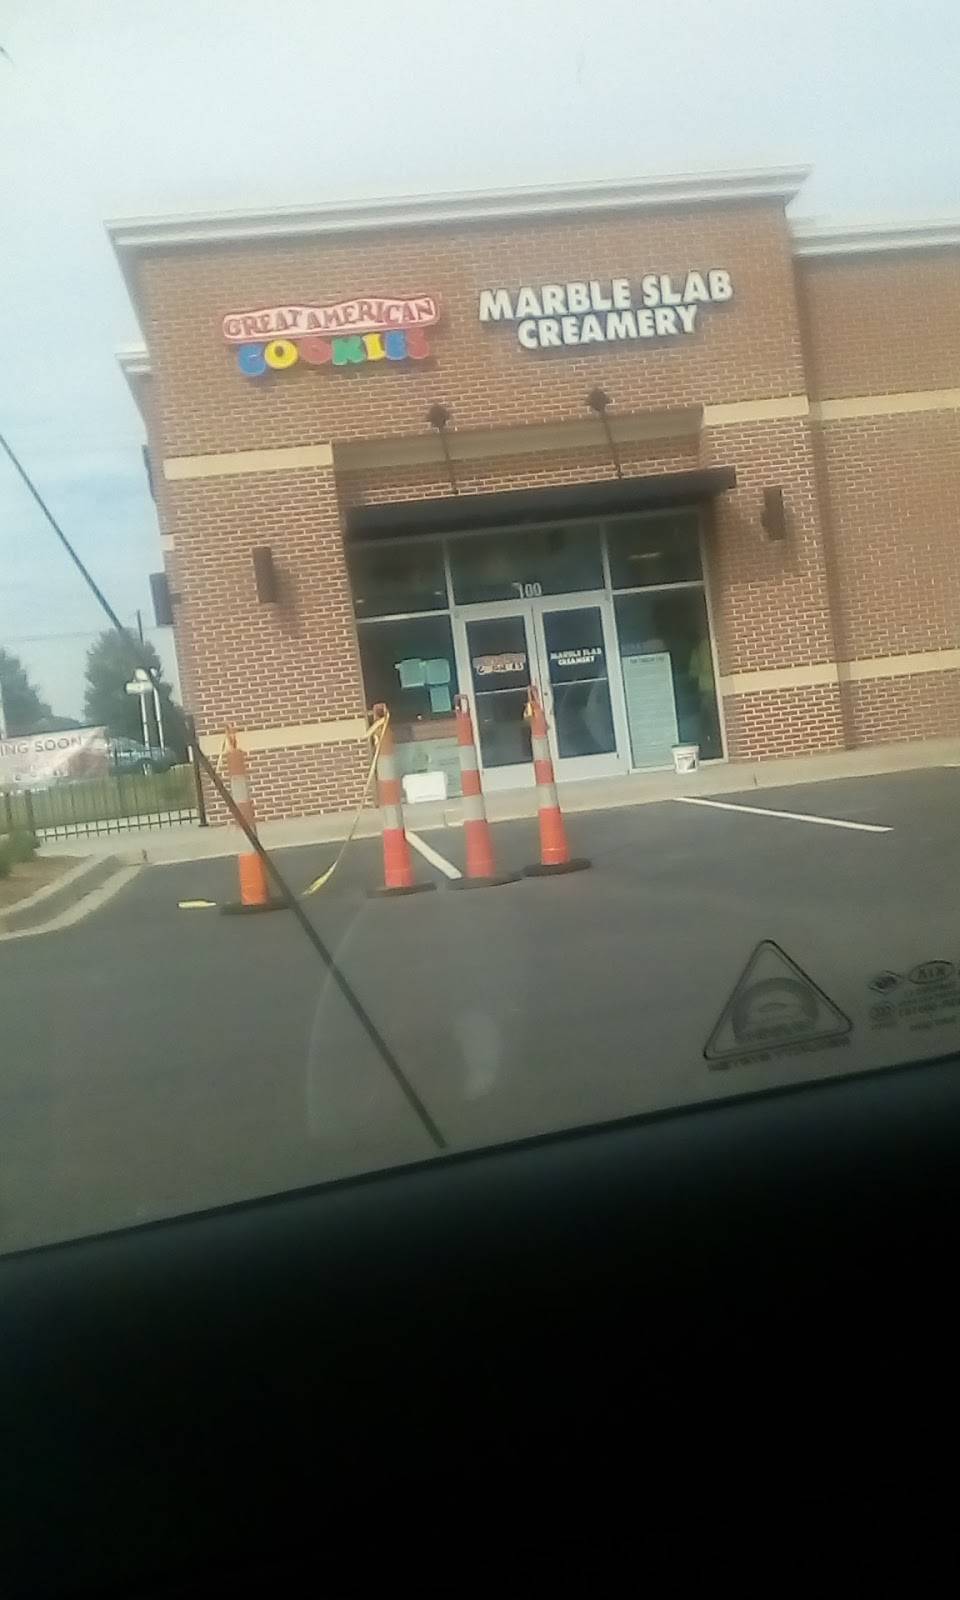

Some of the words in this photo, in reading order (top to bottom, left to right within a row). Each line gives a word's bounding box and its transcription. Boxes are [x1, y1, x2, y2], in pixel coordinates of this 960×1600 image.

[479, 278, 631, 321] MARBLE
[641, 268, 734, 308] SLAB
[224, 311, 300, 337] GREAT
[306, 299, 436, 331] AMERICAN
[517, 304, 698, 350] CREAMERY
[36, 737, 82, 752] SOON
